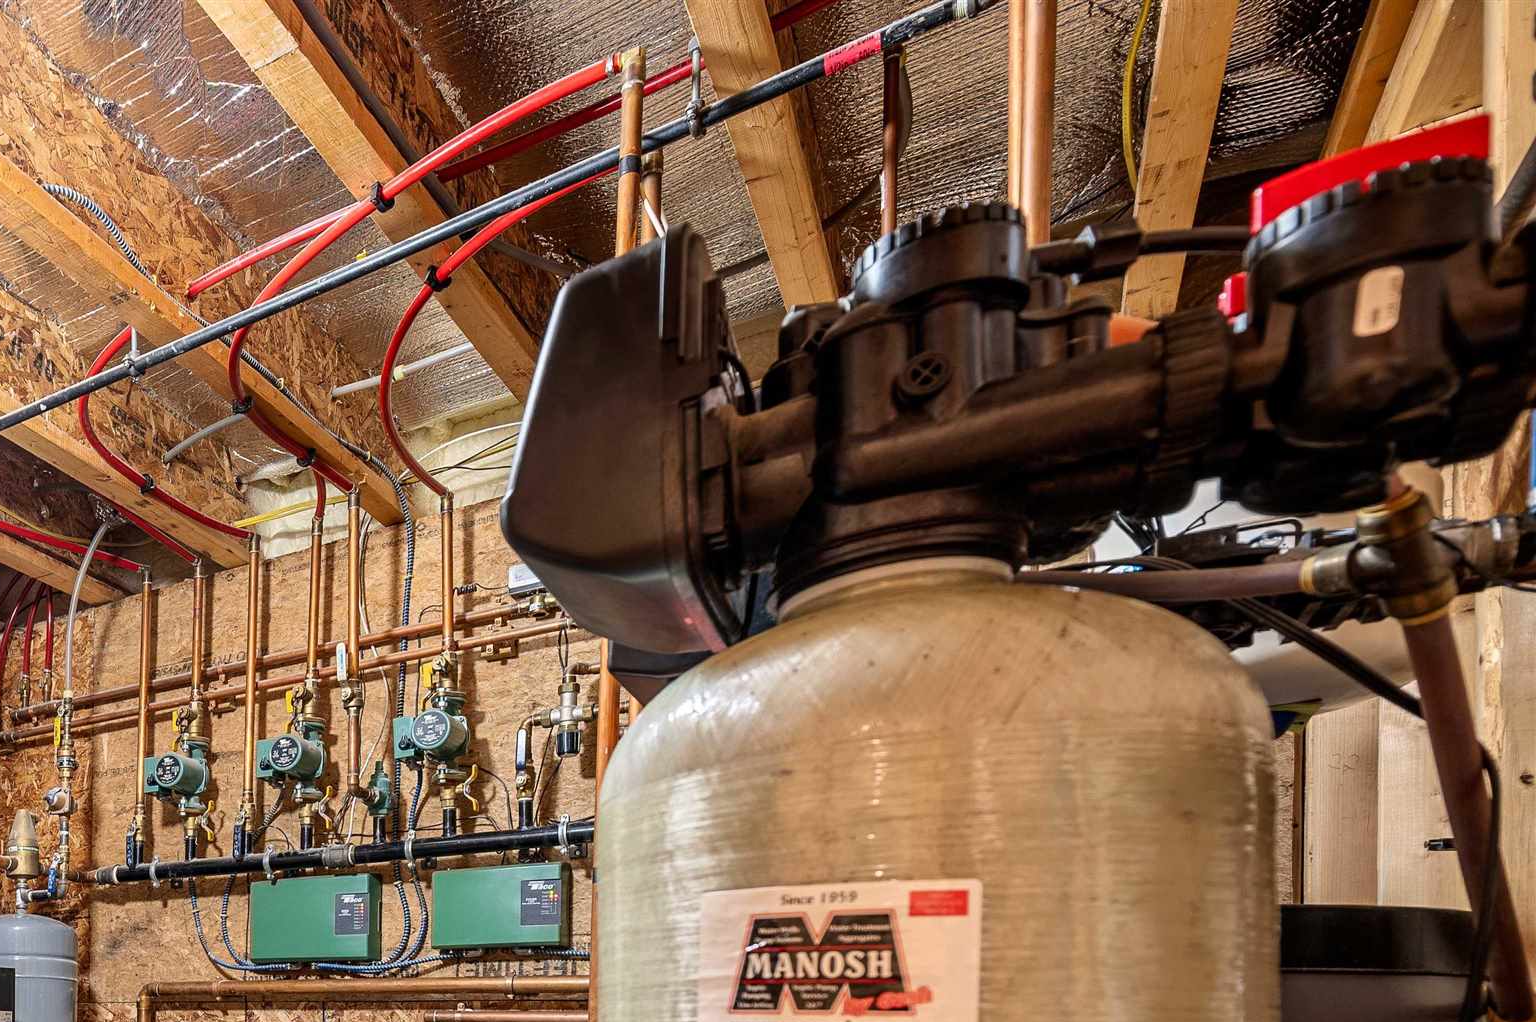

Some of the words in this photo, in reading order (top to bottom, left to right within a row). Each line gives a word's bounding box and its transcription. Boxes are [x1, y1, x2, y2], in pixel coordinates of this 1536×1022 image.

[780, 893, 815, 906] Since
[820, 891, 858, 904] 1959
[746, 950, 893, 980] MANOSH
